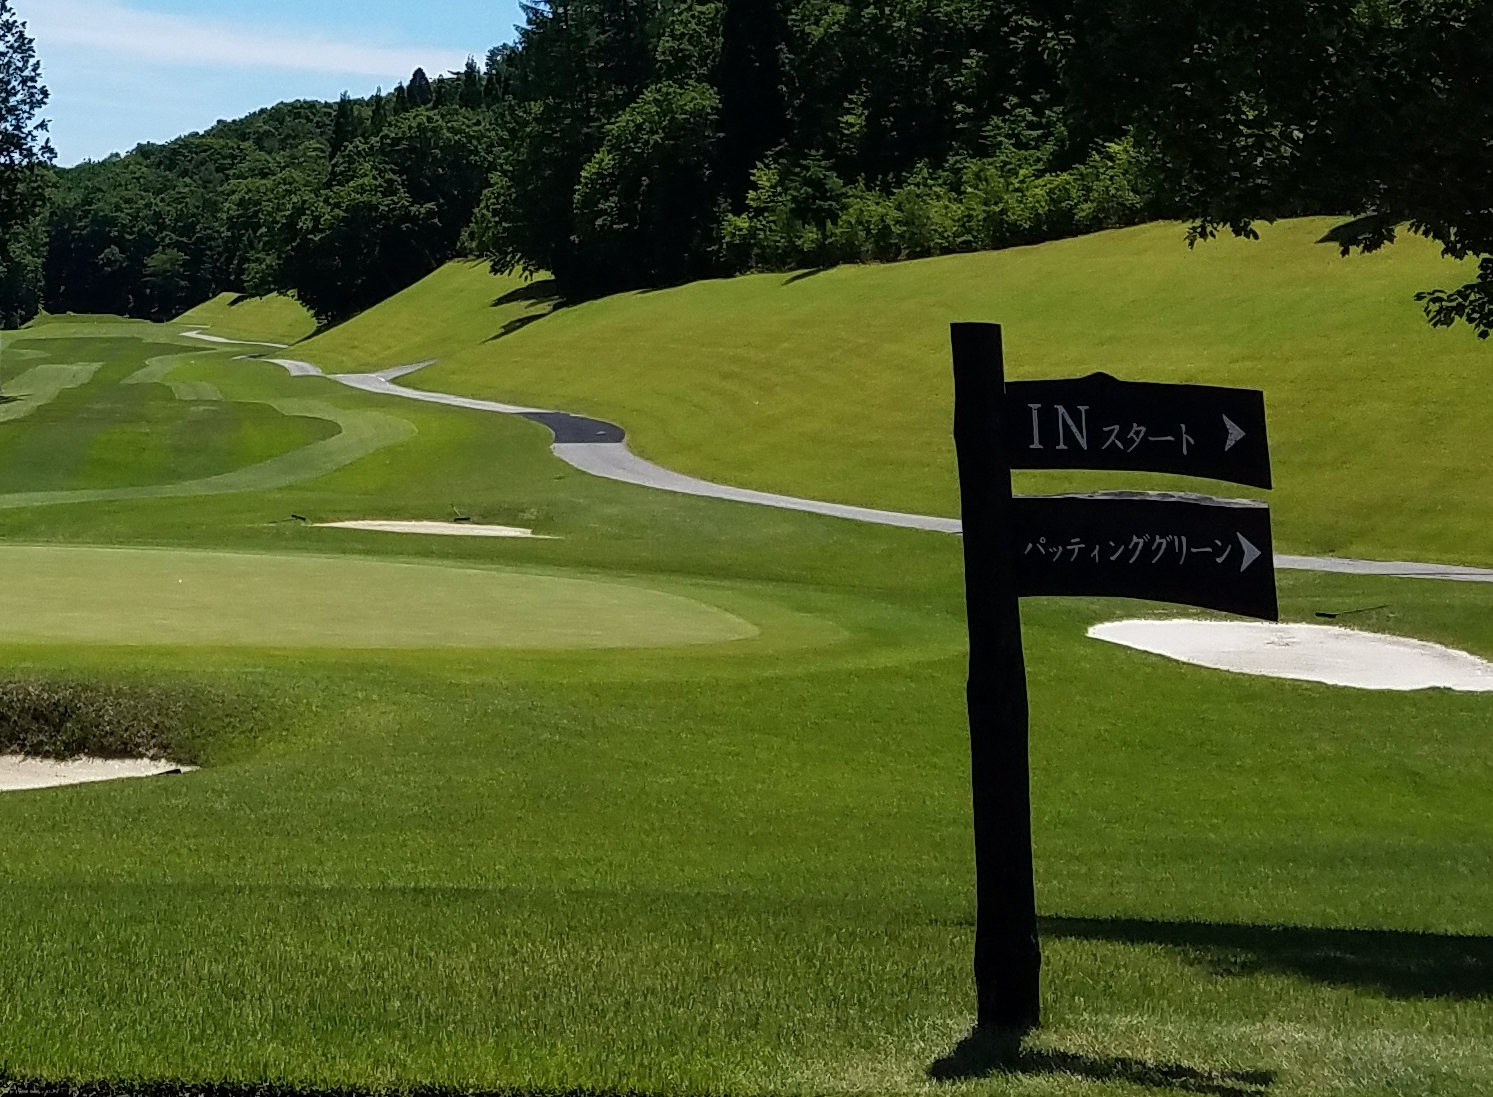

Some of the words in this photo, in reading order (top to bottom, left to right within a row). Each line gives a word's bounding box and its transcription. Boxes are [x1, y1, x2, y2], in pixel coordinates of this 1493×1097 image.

[1027, 403, 1090, 450] IN
[1101, 423, 1195, 455] スタート
[1024, 533, 1232, 564] パッティンググリーン
